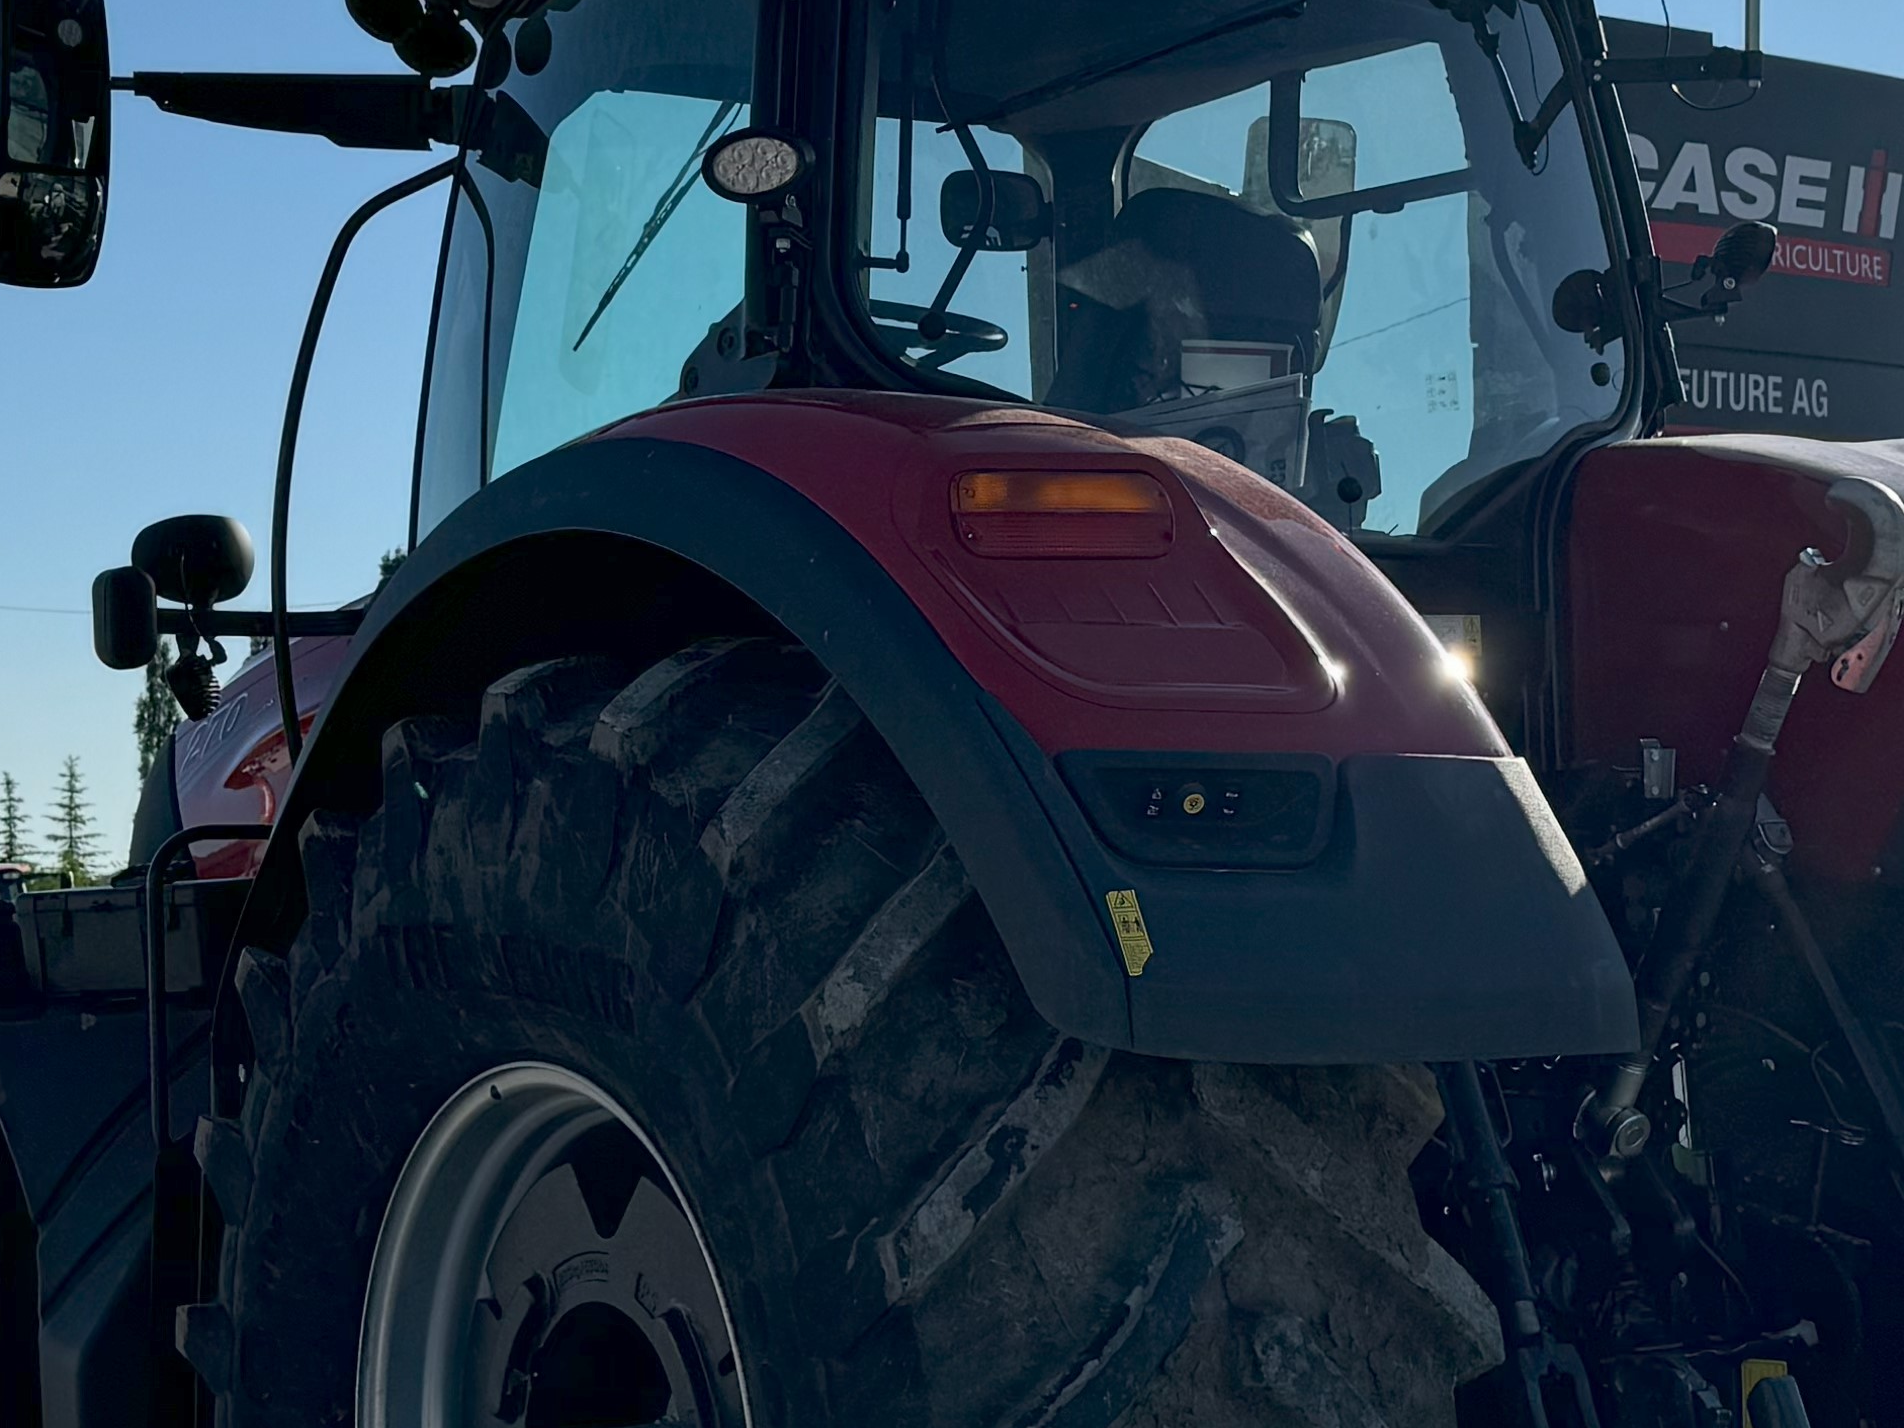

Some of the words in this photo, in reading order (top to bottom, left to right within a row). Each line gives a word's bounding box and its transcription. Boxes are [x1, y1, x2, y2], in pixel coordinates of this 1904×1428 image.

[1628, 132, 1832, 229] CASE
[1772, 242, 1884, 281] RICULTURE
[1792, 378, 1829, 418] AG
